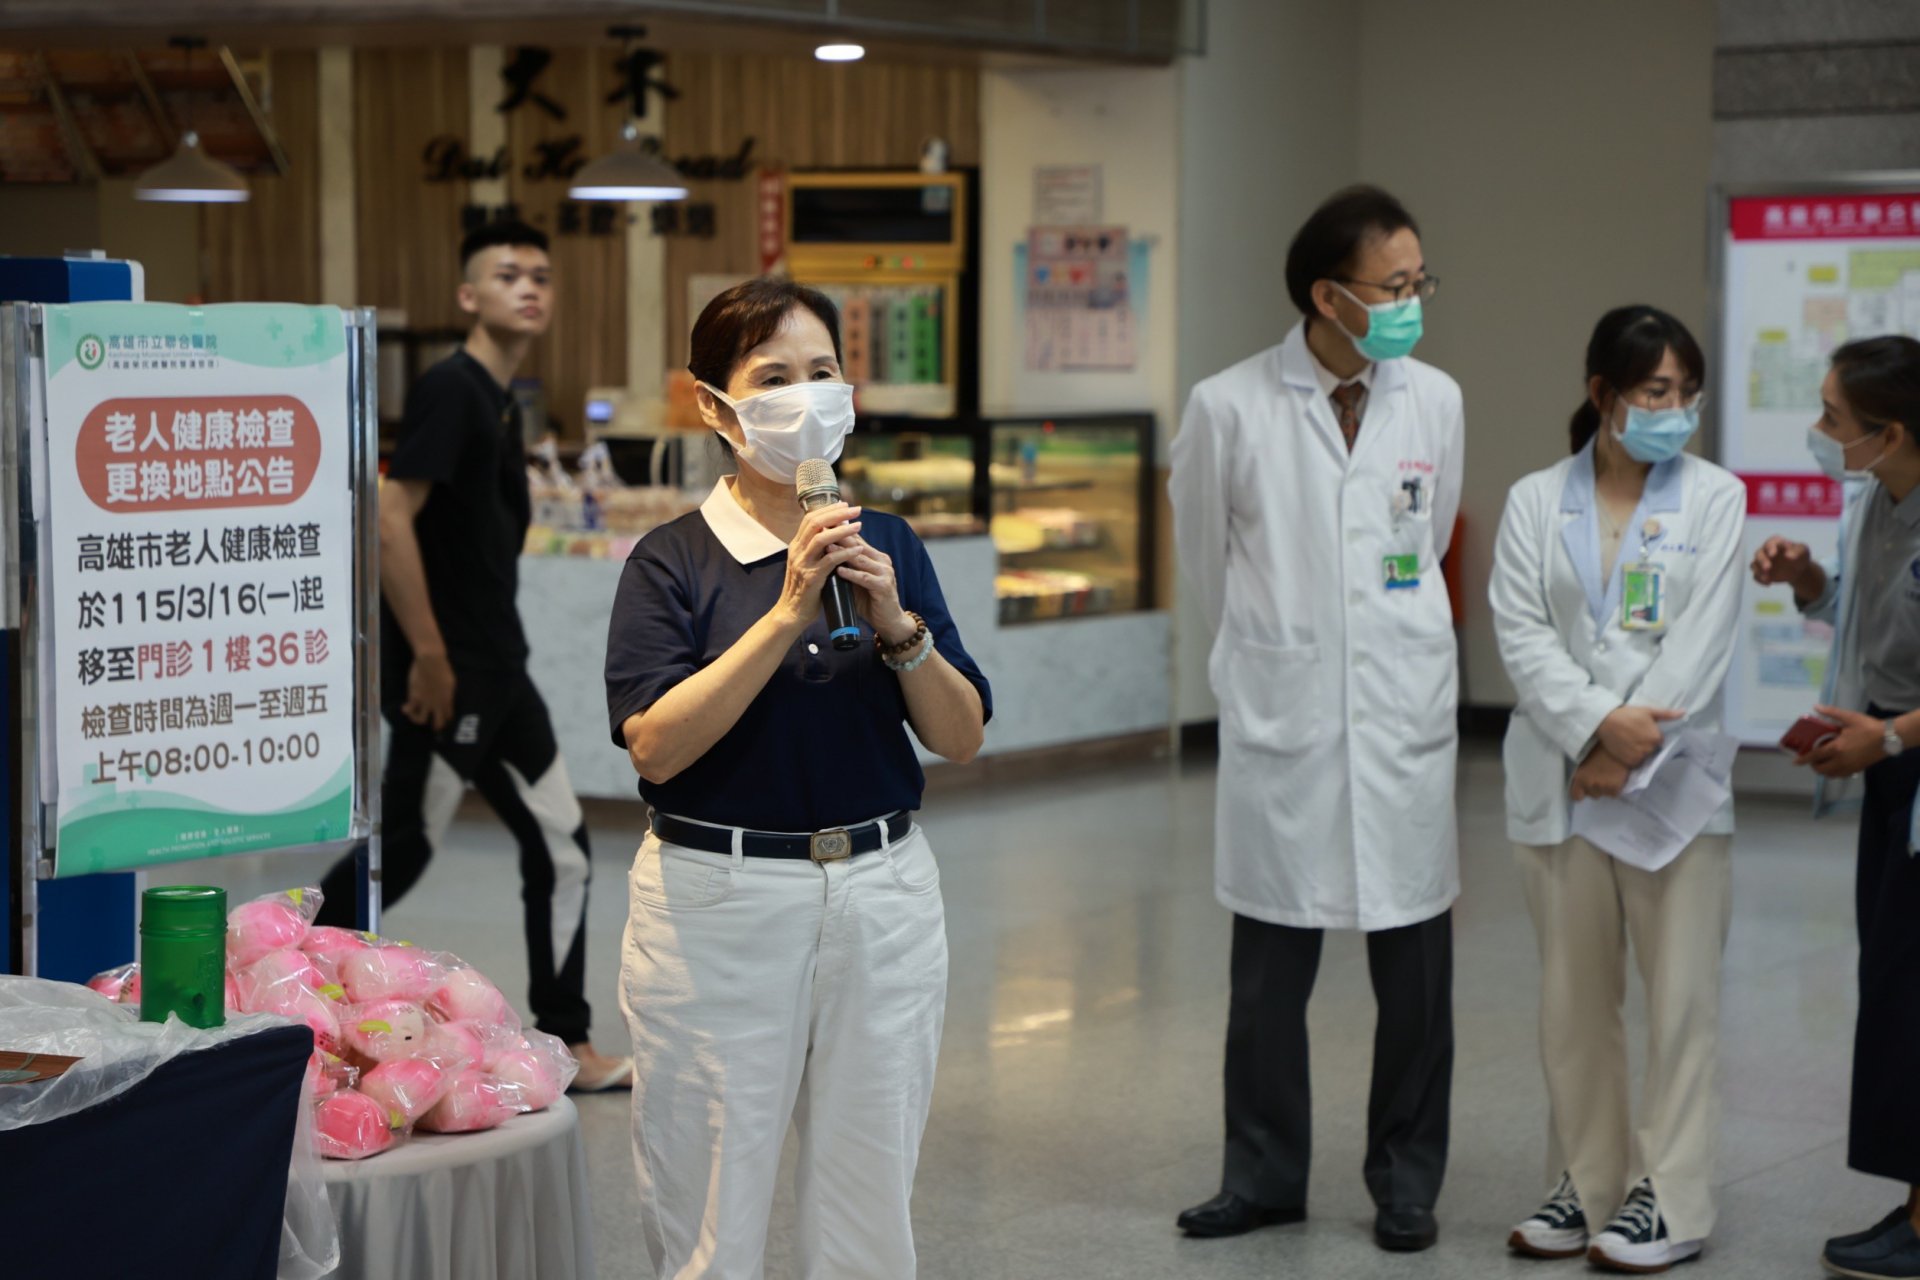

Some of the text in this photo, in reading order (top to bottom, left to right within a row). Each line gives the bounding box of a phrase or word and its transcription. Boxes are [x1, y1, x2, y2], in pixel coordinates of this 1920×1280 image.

[104, 408, 296, 454] 老人健康檢查
[105, 456, 295, 504] 更換地點公告
[77, 522, 322, 573] 高雄市老人健康檢查
[77, 575, 324, 630] 於115/3/16(一)起
[77, 628, 330, 686] 移至門診1樓36診
[81, 684, 329, 740] 檢查時間為週一至週五
[90, 732, 321, 785] 上午08:00-10:00
